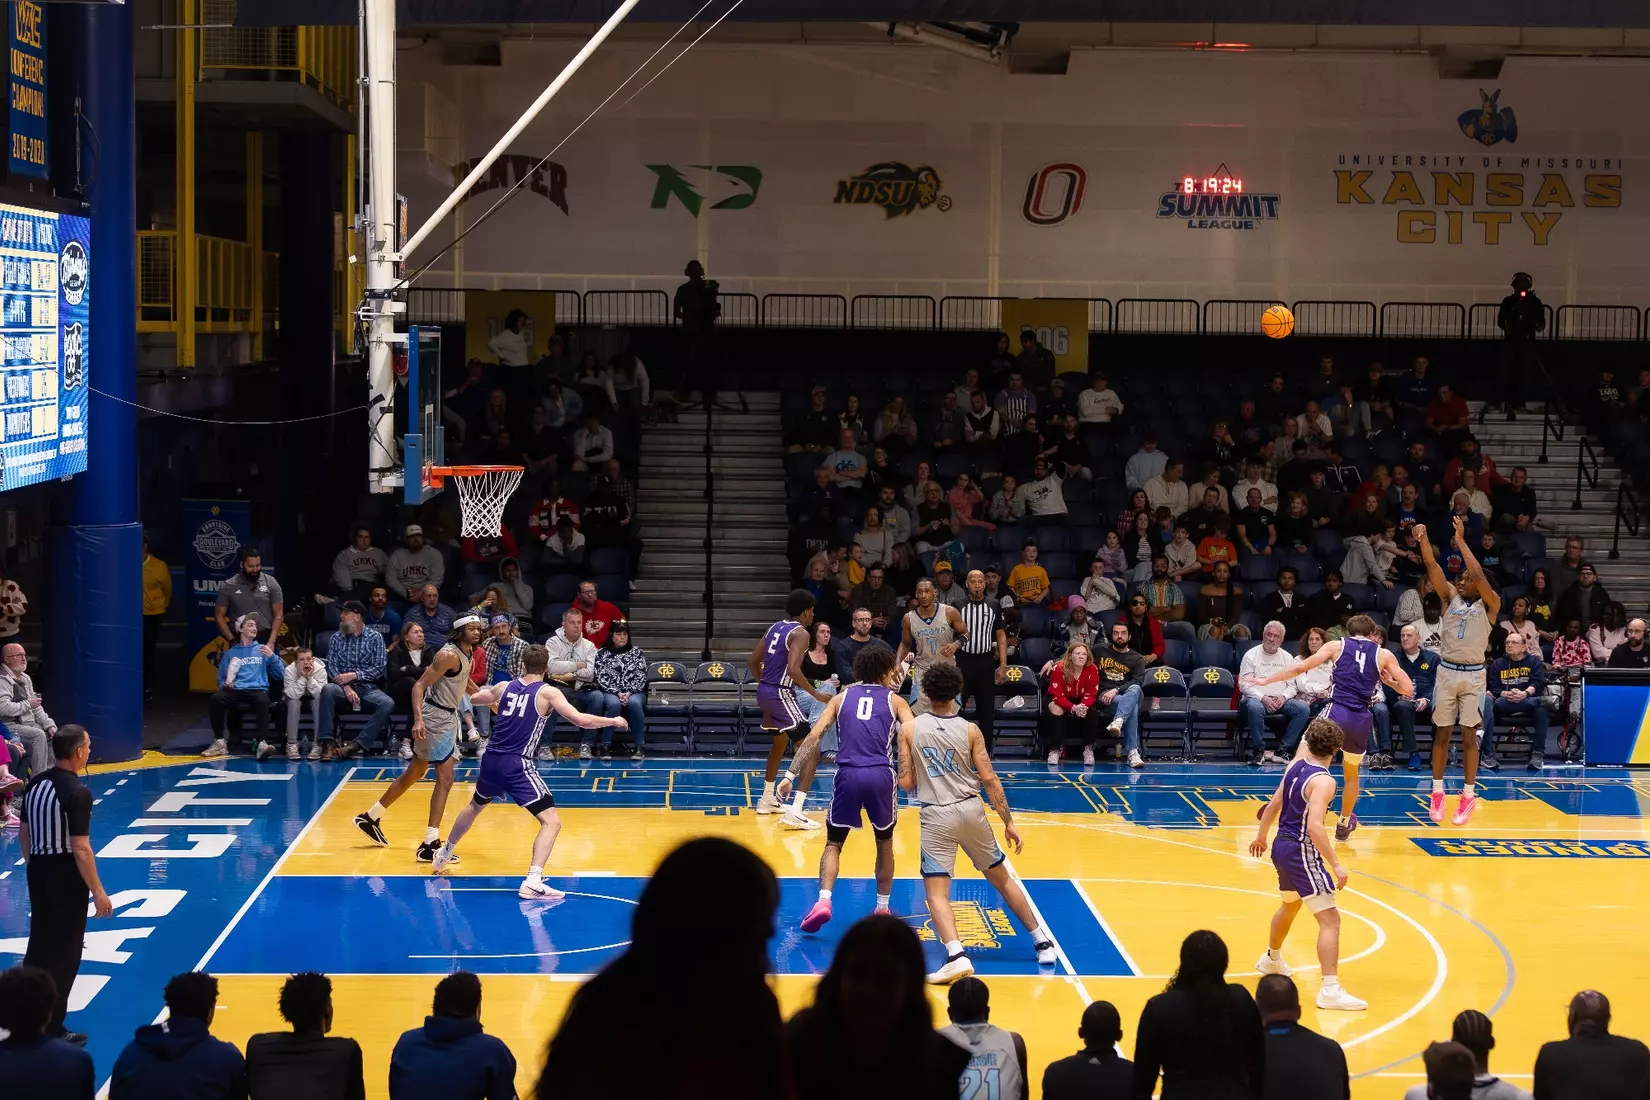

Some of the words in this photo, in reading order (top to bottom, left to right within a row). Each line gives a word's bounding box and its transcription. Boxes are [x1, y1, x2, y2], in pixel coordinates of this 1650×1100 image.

[1338, 154, 1466, 168] UNIVERSITY
[1483, 156, 1504, 168] OF
[1521, 157, 1623, 170] MISSOURI
[833, 179, 916, 207] NDSU
[1183, 177, 1243, 194] 8:19:24
[1333, 170, 1623, 208] KANSAS
[1156, 192, 1281, 220] SUMMIT
[1187, 219, 1255, 231] LEAGUE
[1396, 210, 1563, 245] CITY
[1021, 326, 1070, 355] 06
[199, 537, 234, 550] BOULEVARD
[402, 565, 428, 577] UMKC
[767, 632, 781, 655] 2
[1355, 651, 1366, 674] 4
[502, 692, 530, 718] 34
[856, 697, 874, 721] 0
[1288, 776, 1298, 799] 1
[96, 767, 295, 858] CITY
[958, 1067, 1002, 1100] 21
